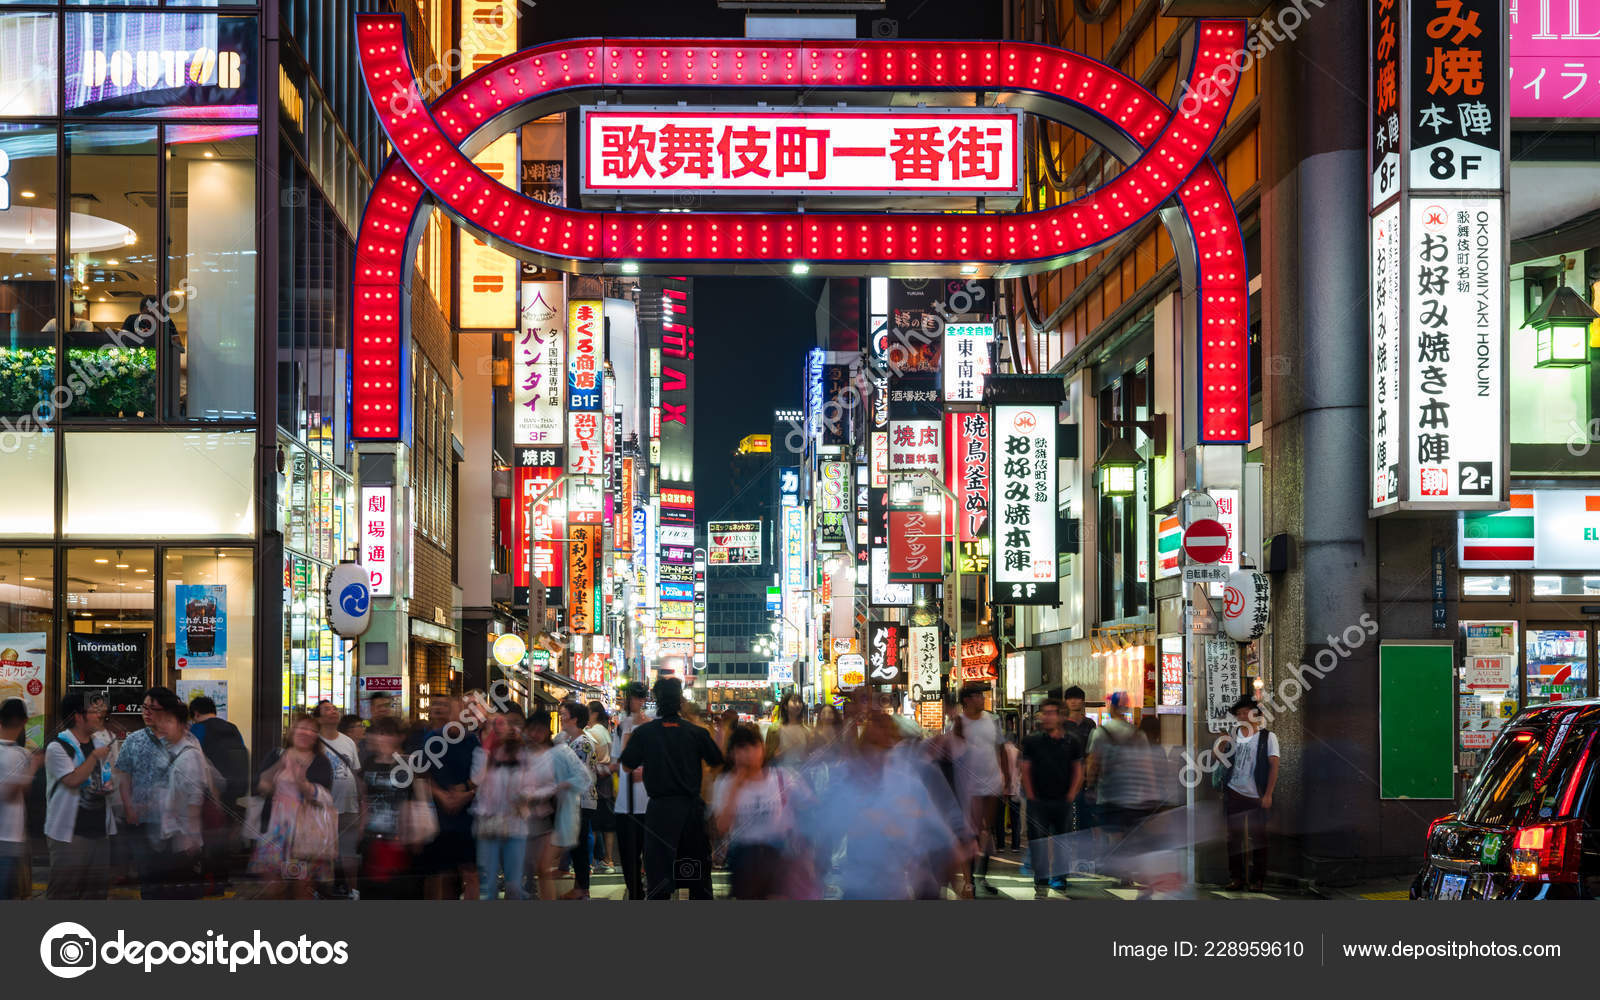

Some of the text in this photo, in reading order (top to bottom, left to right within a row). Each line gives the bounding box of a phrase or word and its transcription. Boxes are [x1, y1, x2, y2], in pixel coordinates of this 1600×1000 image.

[1377, 0, 1396, 116] み焼
[1510, 63, 1600, 100] ィラ
[1419, 101, 1492, 137] 本陣
[601, 123, 1003, 181] 歌舞伎町一番街
[1429, 146, 1482, 180] 8F
[1380, 161, 1396, 194] 8F
[1457, 210, 1470, 293] 歌舞伎町名物
[1476, 210, 1490, 397] OKONOMIYAKI HONJIN
[576, 305, 597, 389] まぐろ商店
[1418, 232, 1450, 465] お好み焼き本陣
[520, 328, 544, 412] バンタイ
[548, 328, 559, 407] タイ国料理専門店
[957, 338, 974, 400] 東南荘
[571, 394, 600, 408] B1F
[529, 431, 548, 441] 3F
[893, 424, 939, 448] 焼肉
[522, 450, 556, 466] 焼肉
[963, 414, 987, 538] 焼鳥釜めし
[1460, 465, 1492, 490] 2F
[577, 512, 595, 522] 4F
[1004, 434, 1032, 572] お好み焼本陣
[368, 495, 386, 587] 劇場通り
[904, 513, 929, 571] ステップ
[1584, 527, 1600, 541] EL
[1012, 583, 1037, 598] 2F
[1186, 569, 1227, 580] 自転車を除く
[77, 642, 137, 652] information
[1475, 658, 1501, 668] ATM
